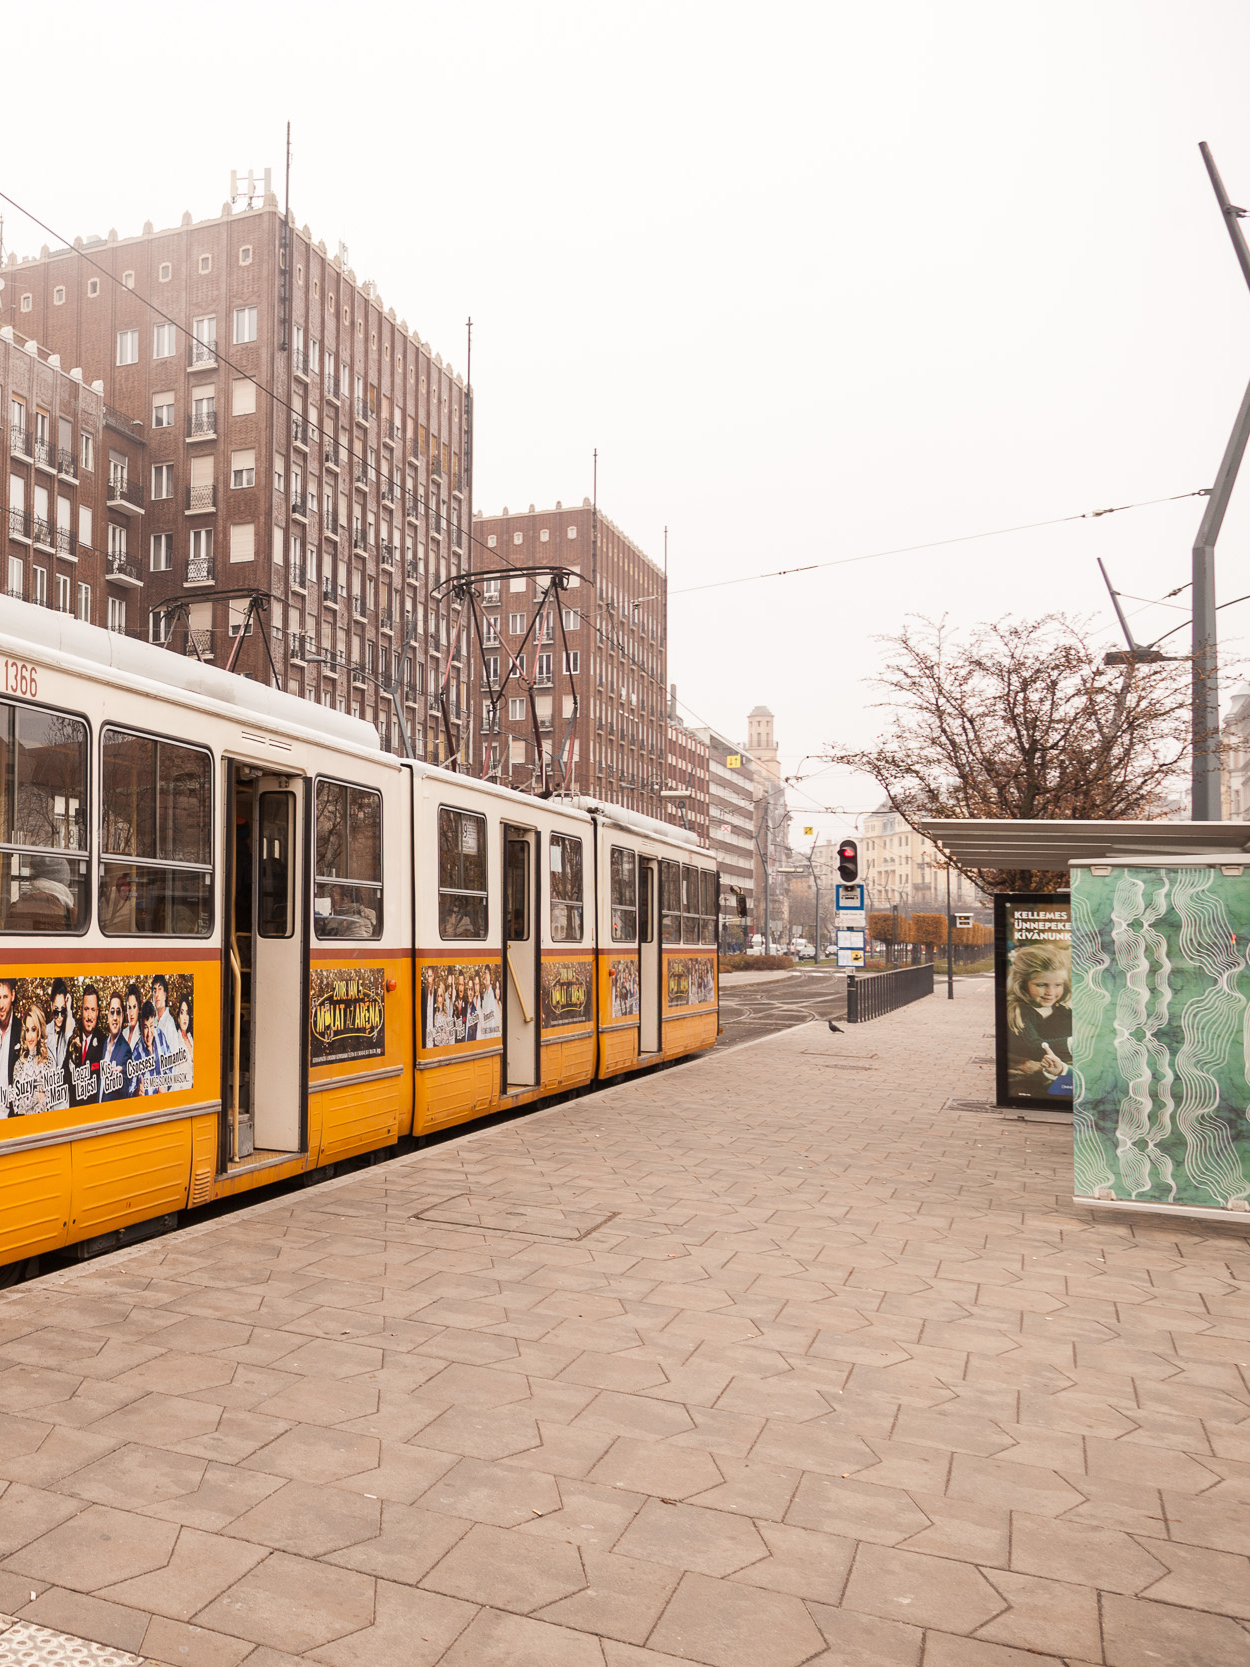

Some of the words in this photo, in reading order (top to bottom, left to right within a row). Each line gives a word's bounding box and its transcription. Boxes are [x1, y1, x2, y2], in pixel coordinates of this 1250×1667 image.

[4, 659, 37, 697] 1366
[1014, 911, 1068, 920] KELLEMES
[1014, 929, 1073, 941] KÍVÁNUNK
[160, 1047, 187, 1069] Romantic
[72, 1061, 90, 1083] Lagzi
[15, 1079, 33, 1098] Suzy
[50, 1084, 68, 1105] Mary
[76, 1075, 97, 1099] Lajcsi
